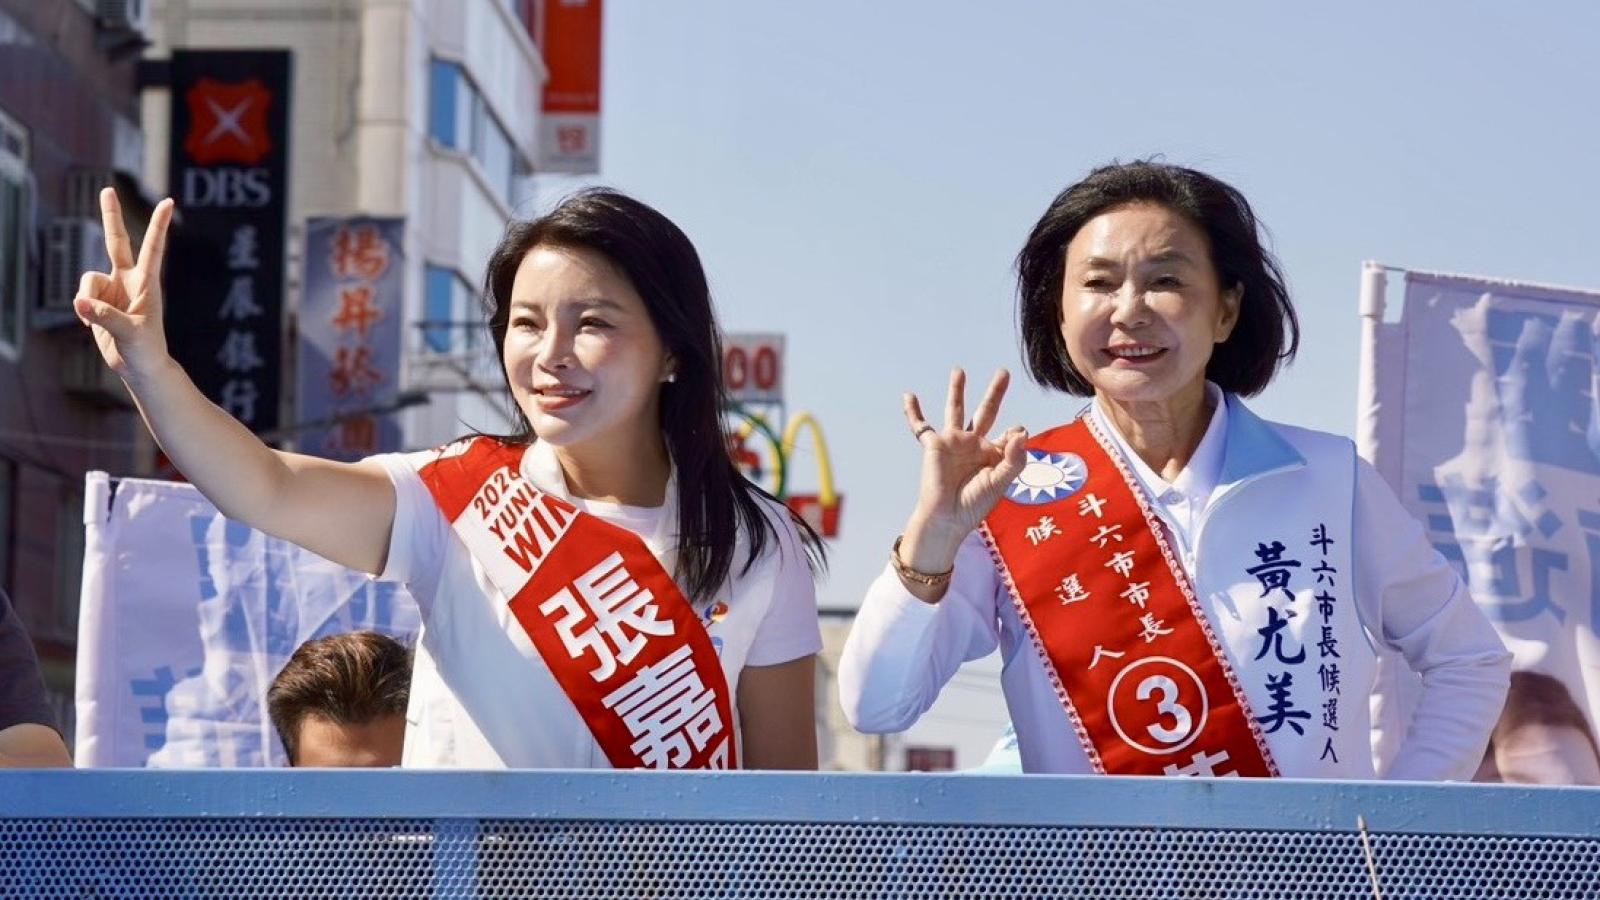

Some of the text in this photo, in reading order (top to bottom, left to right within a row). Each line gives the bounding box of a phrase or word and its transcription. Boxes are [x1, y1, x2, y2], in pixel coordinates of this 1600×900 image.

[183, 168, 271, 208] DBS
[1025, 515, 1126, 670] 候選人
[1078, 493, 1175, 643] 斗六市市長
[1246, 540, 1312, 737] 黃尤美
[1309, 522, 1342, 764] 斗六市長候選人
